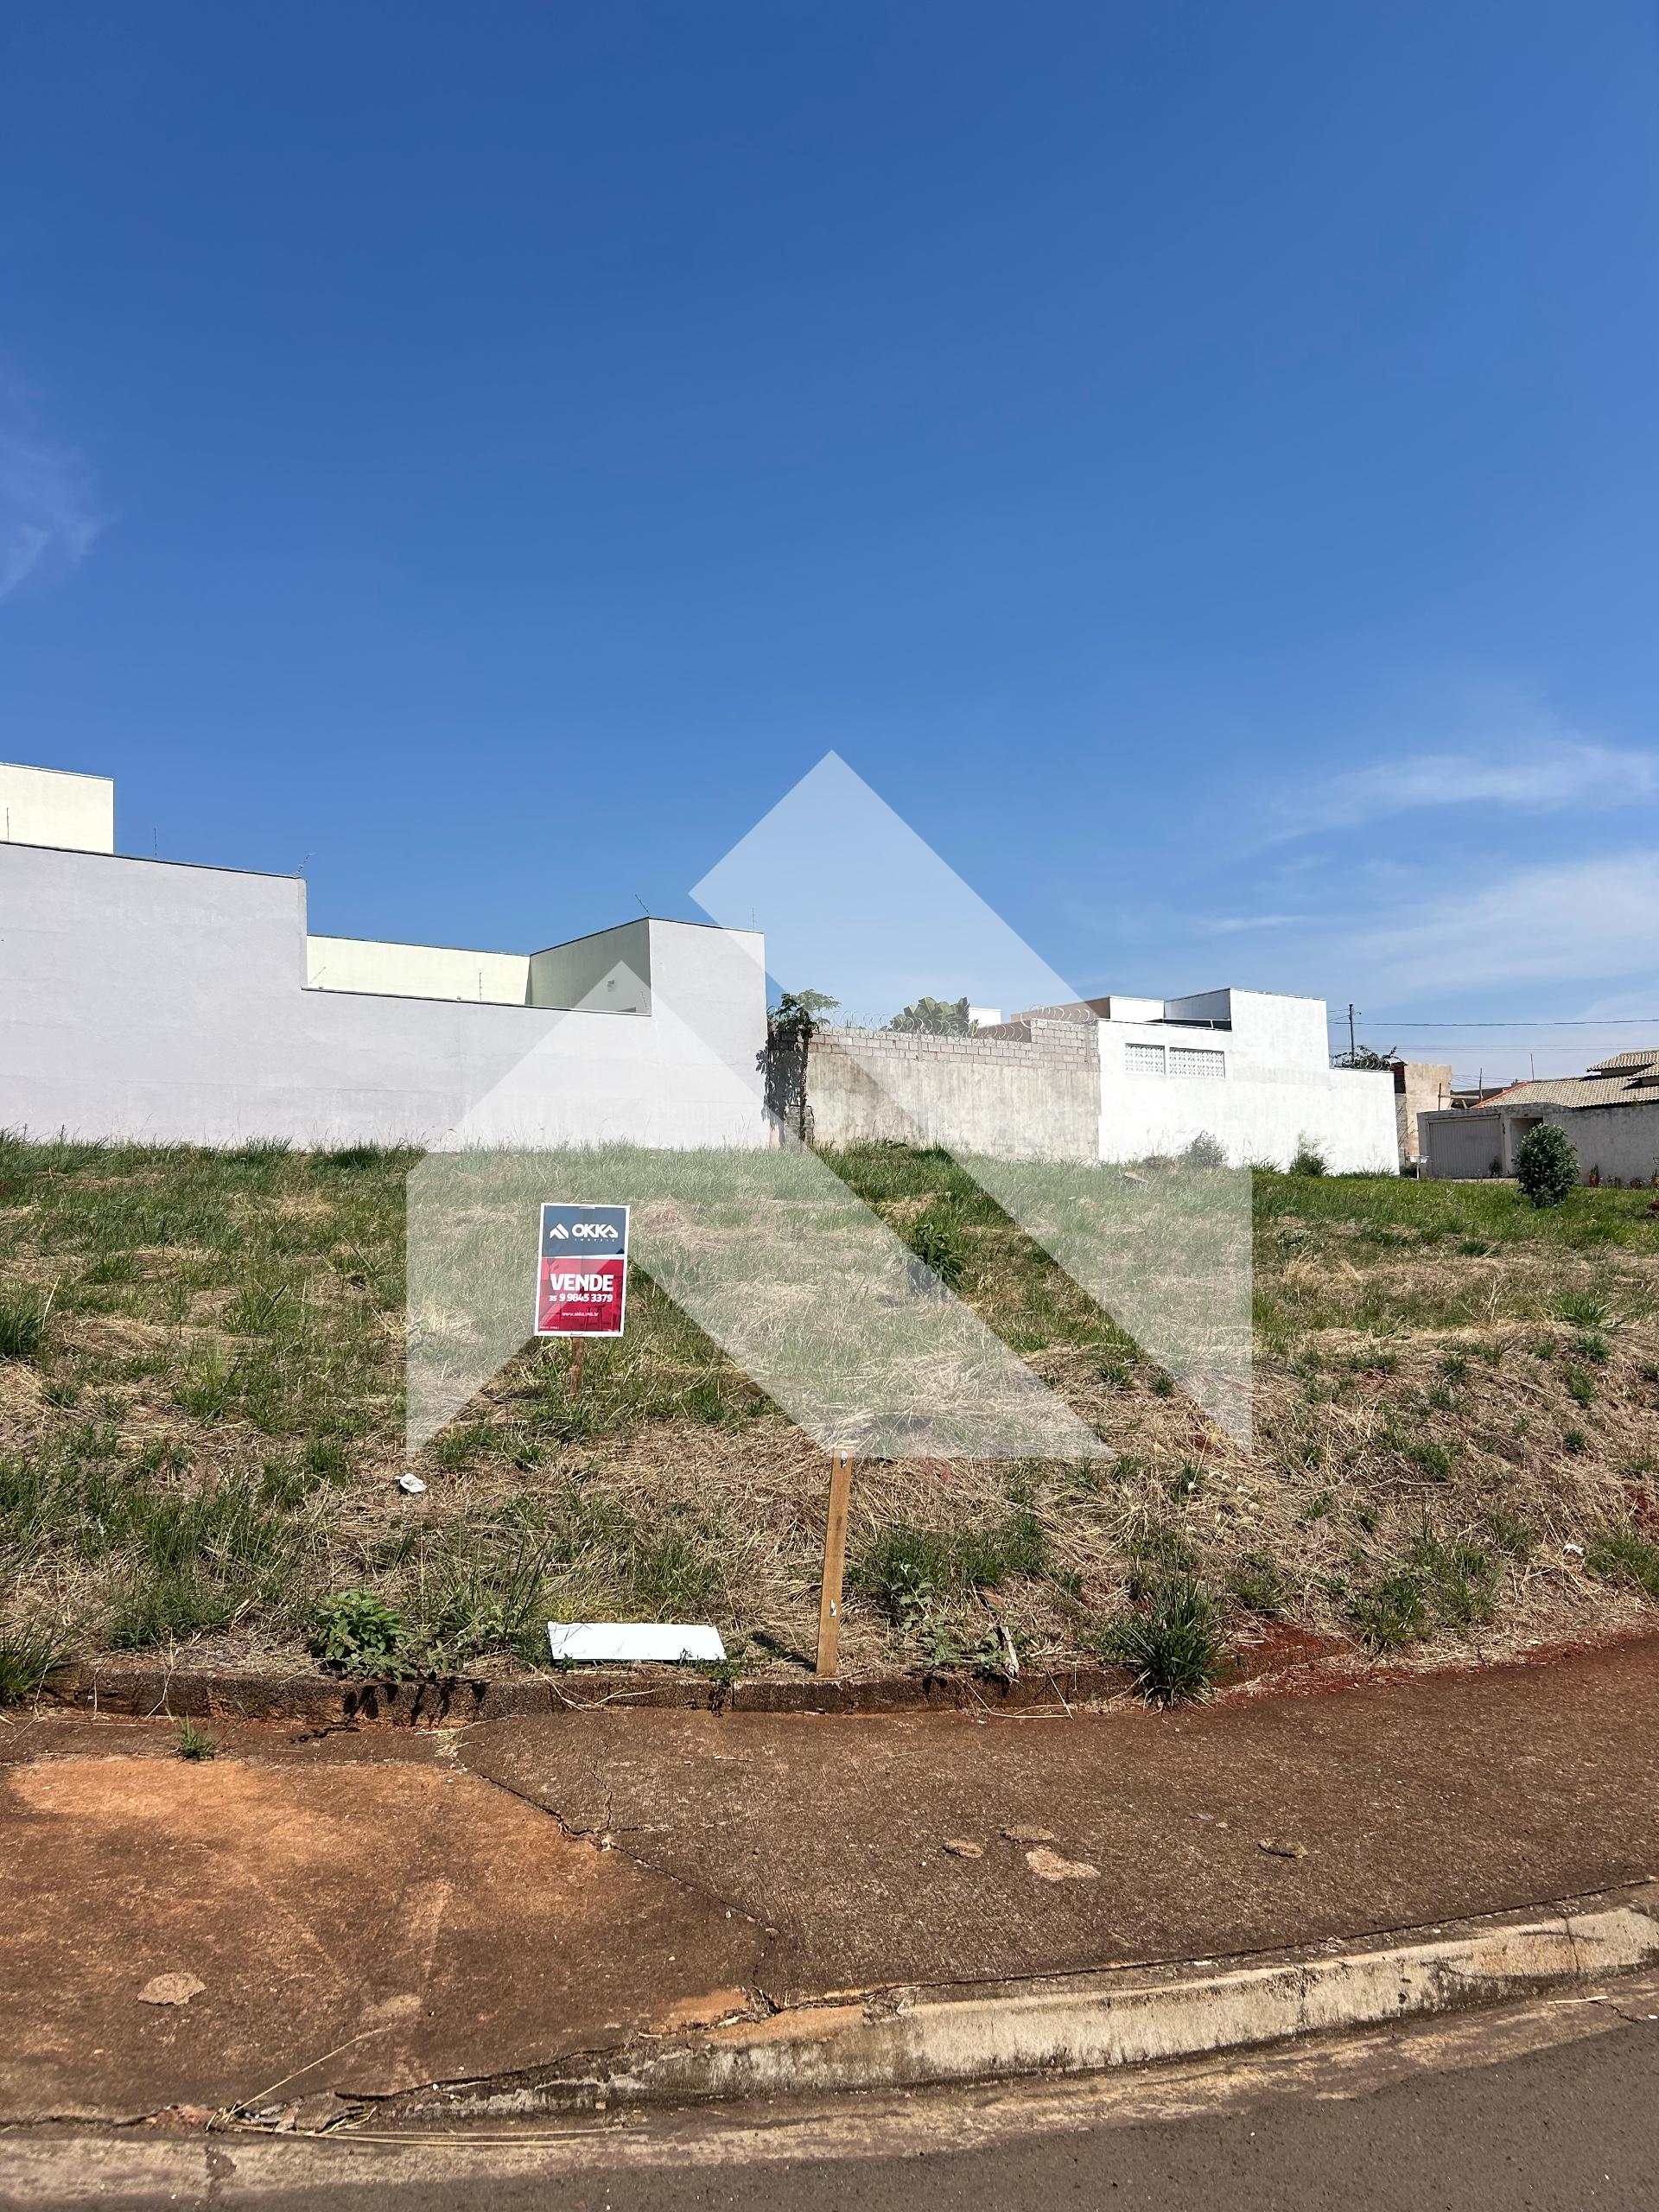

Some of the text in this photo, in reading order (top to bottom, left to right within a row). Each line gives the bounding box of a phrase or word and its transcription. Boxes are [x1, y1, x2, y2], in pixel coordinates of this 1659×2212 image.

[572, 1224, 618, 1237] OKKA
[550, 1274, 613, 1291] VENDE
[559, 1294, 565, 1302] 9
[567, 1294, 590, 1302] 9845
[590, 1294, 613, 1303] 3379
